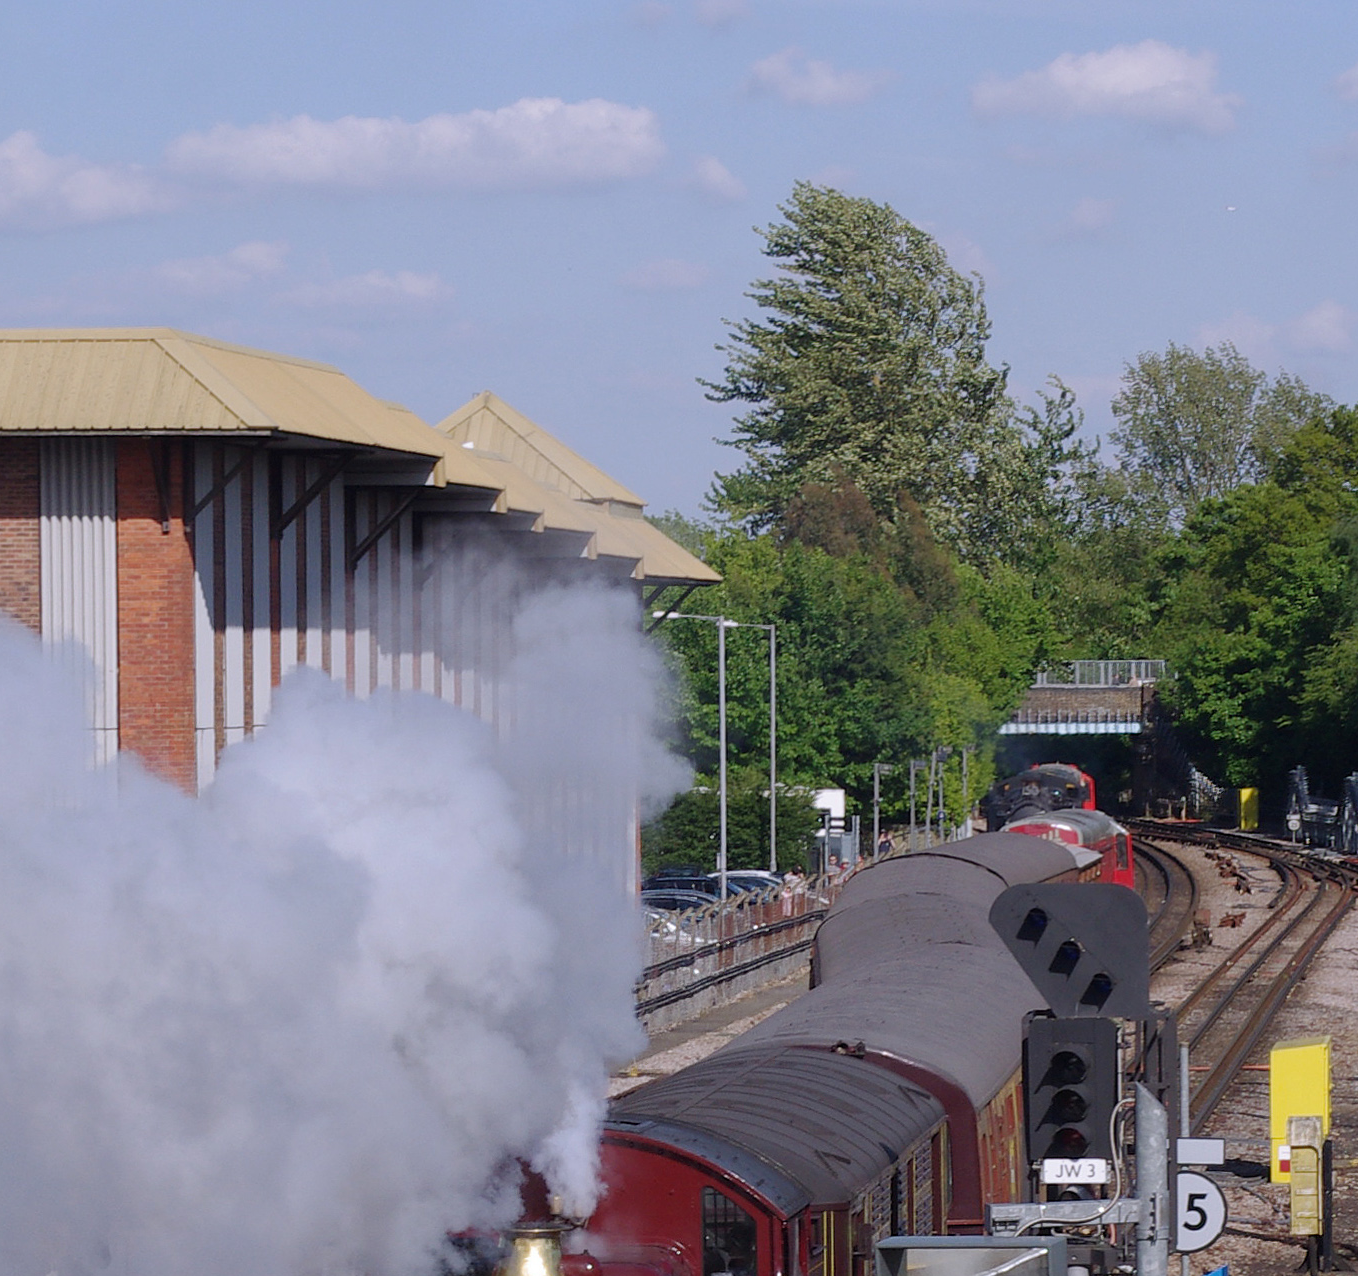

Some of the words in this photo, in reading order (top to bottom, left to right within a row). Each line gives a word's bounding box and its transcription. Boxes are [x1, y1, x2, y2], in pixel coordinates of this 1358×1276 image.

[1055, 1163, 1082, 1178] JW
[1087, 1163, 1096, 1178] 3
[1182, 1193, 1207, 1231] 5
